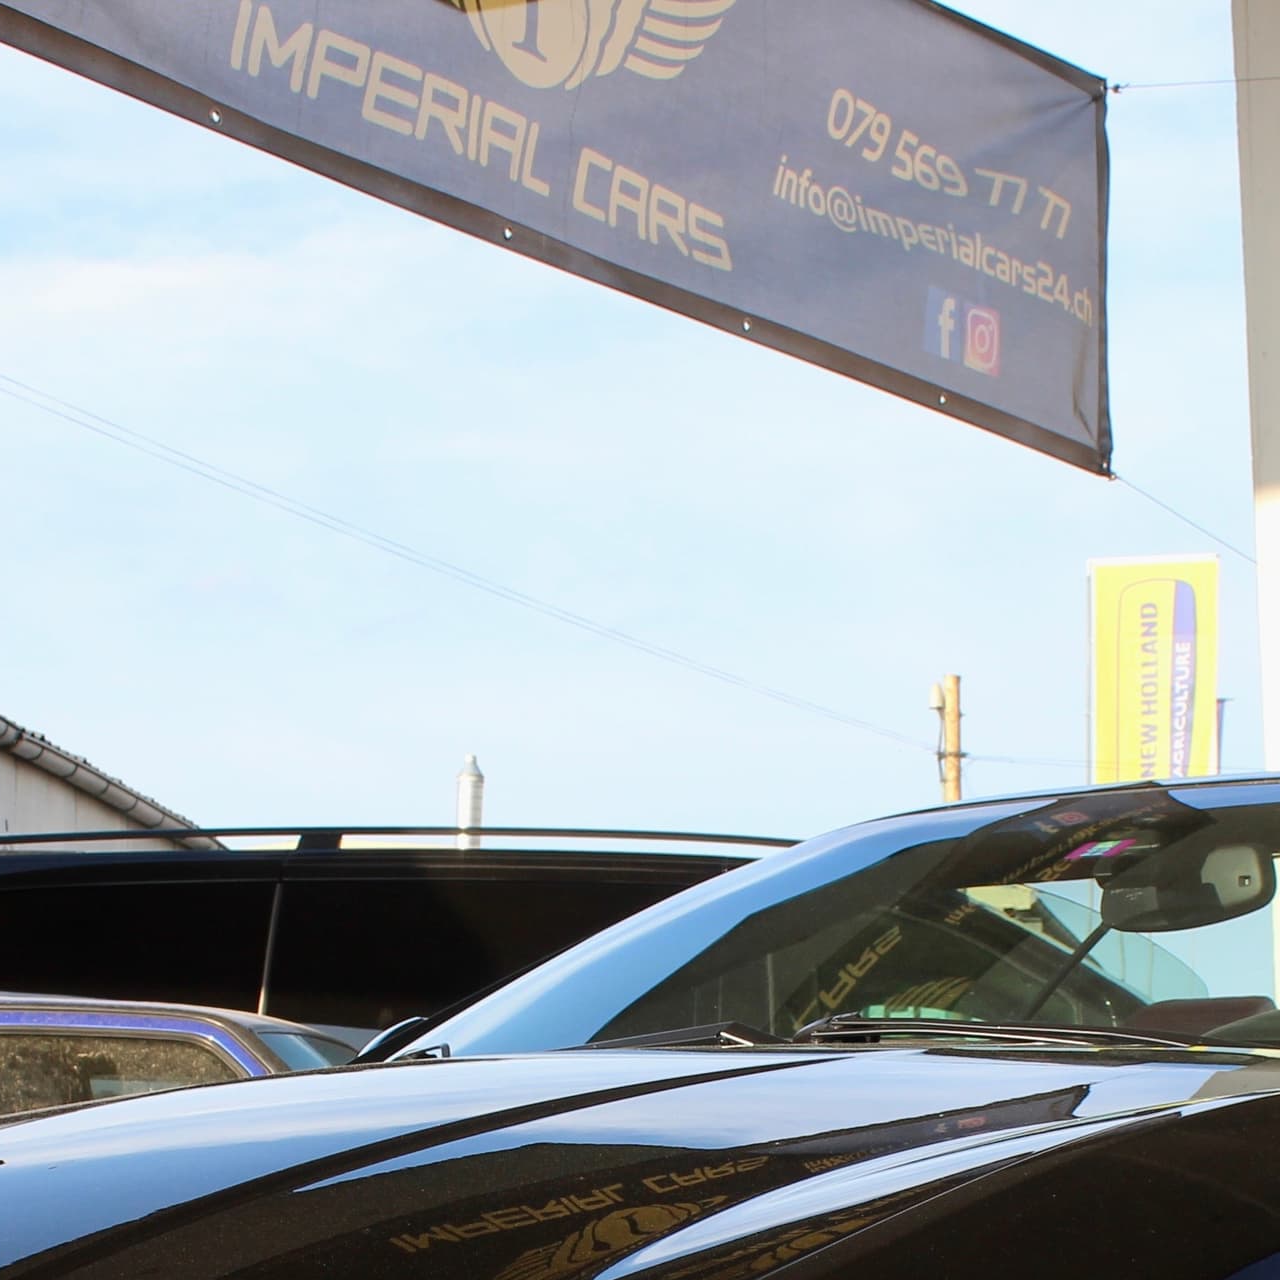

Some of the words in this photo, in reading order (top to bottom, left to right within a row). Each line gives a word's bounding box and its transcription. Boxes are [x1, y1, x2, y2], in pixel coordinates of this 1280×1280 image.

[230, 0, 550, 197] IMPERIAL
[571, 146, 734, 273] CARS
[827, 88, 893, 164] 079
[891, 130, 969, 198] 569
[773, 155, 1094, 329] info@imperialcars24.ch
[1140, 602, 1159, 715] HOLLAND
[1172, 641, 1193, 778] AGRICULTURE
[1137, 726, 1158, 778] NEW
